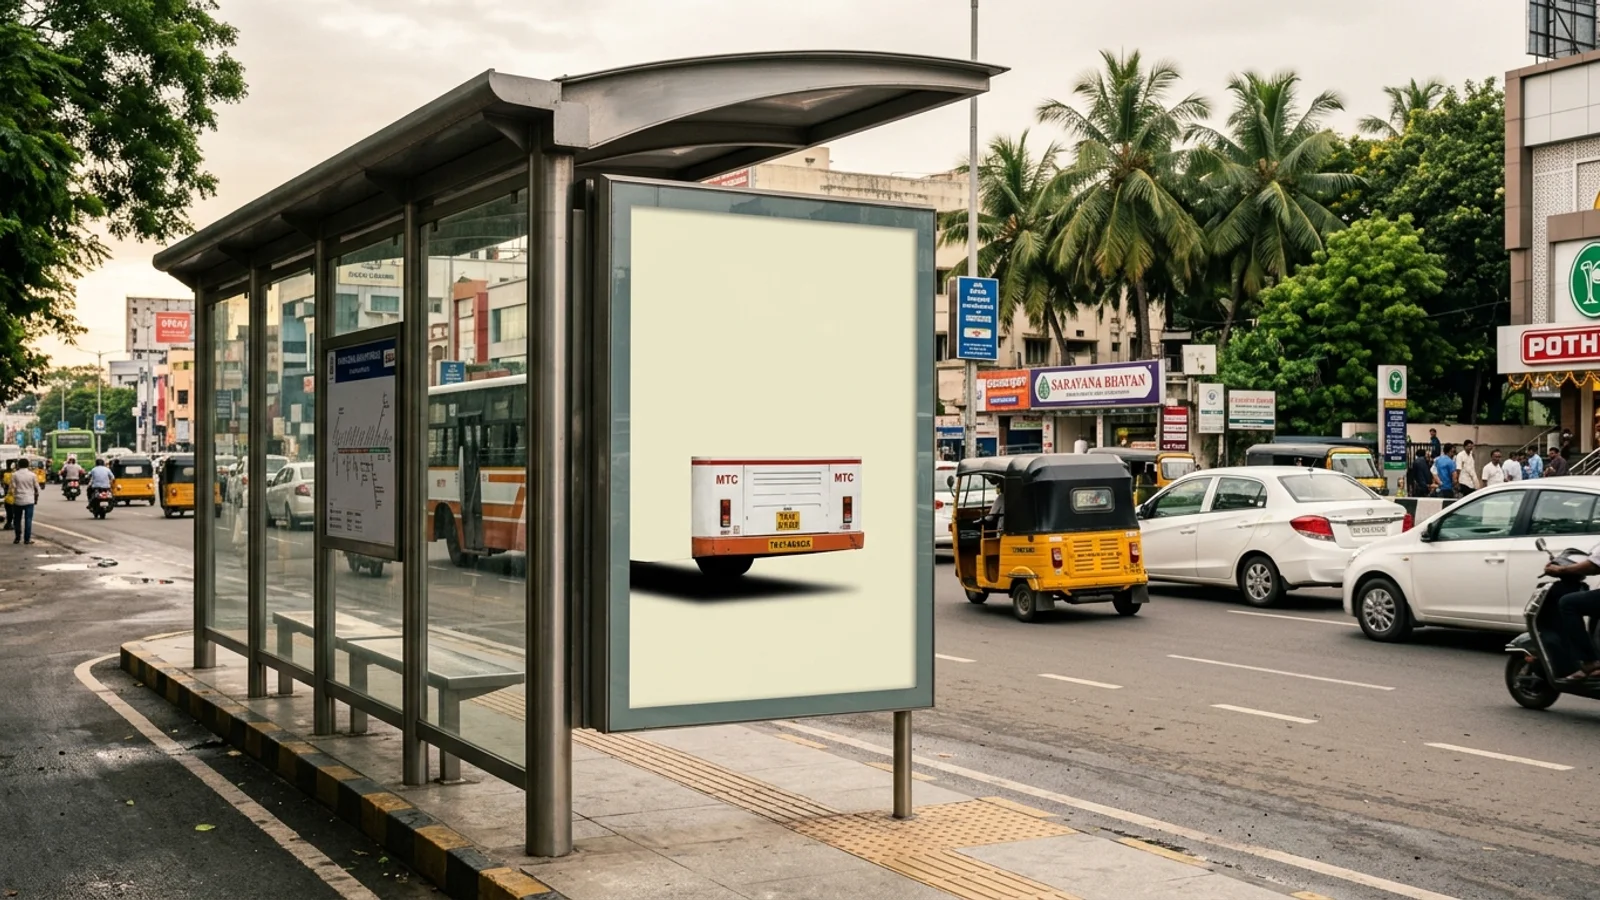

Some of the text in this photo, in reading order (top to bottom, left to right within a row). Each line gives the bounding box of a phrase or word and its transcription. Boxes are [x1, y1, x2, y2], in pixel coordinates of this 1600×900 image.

[1529, 333, 1600, 358] POTH
[715, 474, 739, 485] MTC
[834, 472, 854, 483] MTC
